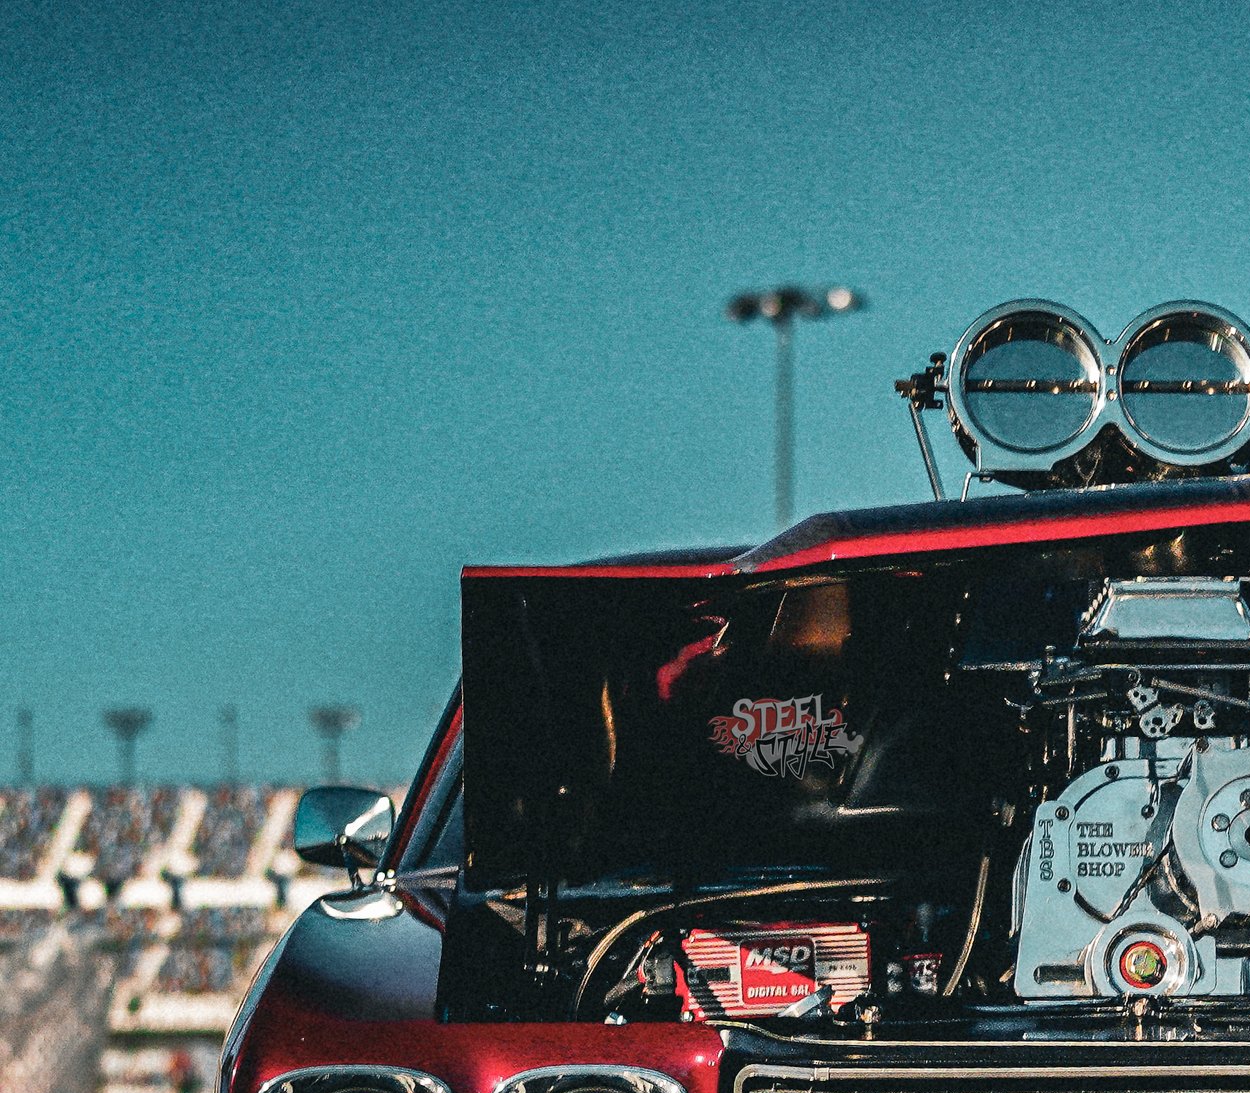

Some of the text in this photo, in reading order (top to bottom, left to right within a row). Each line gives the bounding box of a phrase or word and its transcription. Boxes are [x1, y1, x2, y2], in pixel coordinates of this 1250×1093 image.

[1076, 822, 1114, 838] THE
[1039, 819, 1055, 881] TBS
[1077, 862, 1126, 877] SHOP
[746, 945, 812, 968] MSD
[748, 985, 788, 998] DIGITAL
